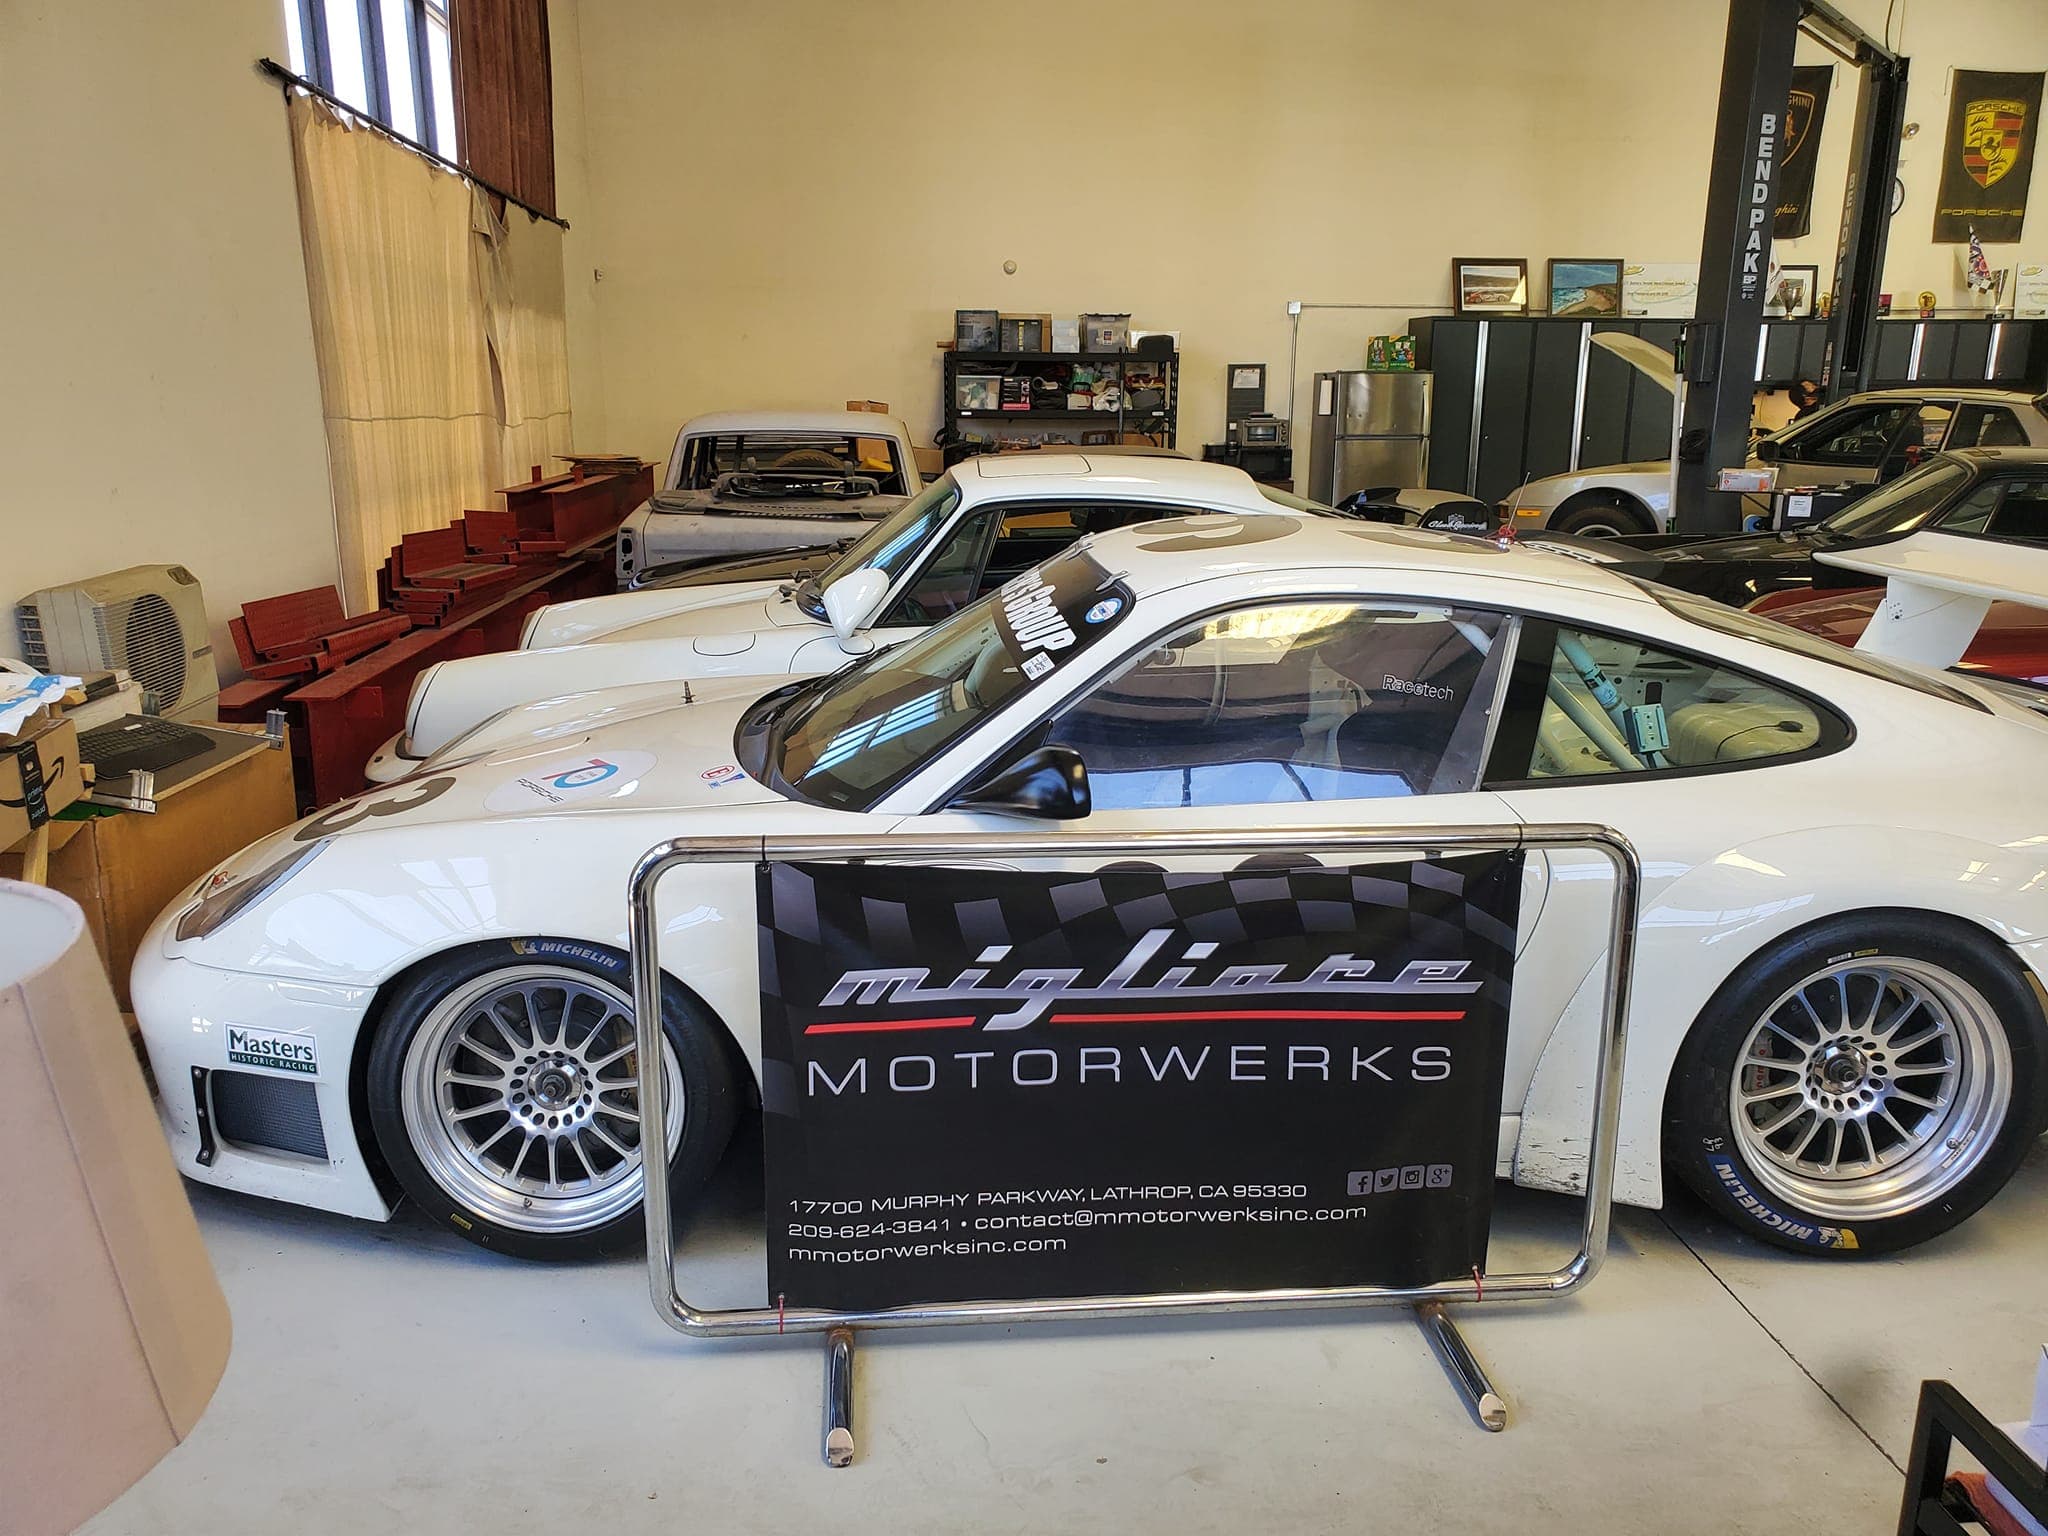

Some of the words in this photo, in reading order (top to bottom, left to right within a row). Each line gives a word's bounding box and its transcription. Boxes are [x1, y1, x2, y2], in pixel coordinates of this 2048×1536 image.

[1967, 103, 2023, 114] PORSCHE
[1940, 208, 2024, 217] PORSCHE
[1004, 584, 1078, 653] GROUP
[1382, 673, 1455, 701] Racetech
[540, 942, 618, 968] MICHELIN
[229, 1029, 314, 1061] Masters
[231, 1053, 275, 1067] HISTORIC
[279, 1060, 316, 1073] RACING
[808, 1044, 1453, 1097] MOTORWERKS
[789, 1200, 864, 1215] 17700
[871, 1193, 970, 1212] MURPHY
[977, 1187, 1086, 1206] PARKWAY,
[1090, 1185, 1194, 1201] LATHROP,
[1199, 1185, 1228, 1199] CA
[1233, 1184, 1307, 1199] 95330
[1715, 1163, 1815, 1240] MICHELIN
[788, 1218, 951, 1240] 209-624-3841
[974, 1205, 1367, 1230] contact@mmotorwerksinc.com
[789, 1237, 1067, 1264] mmotorwerksinc.com
